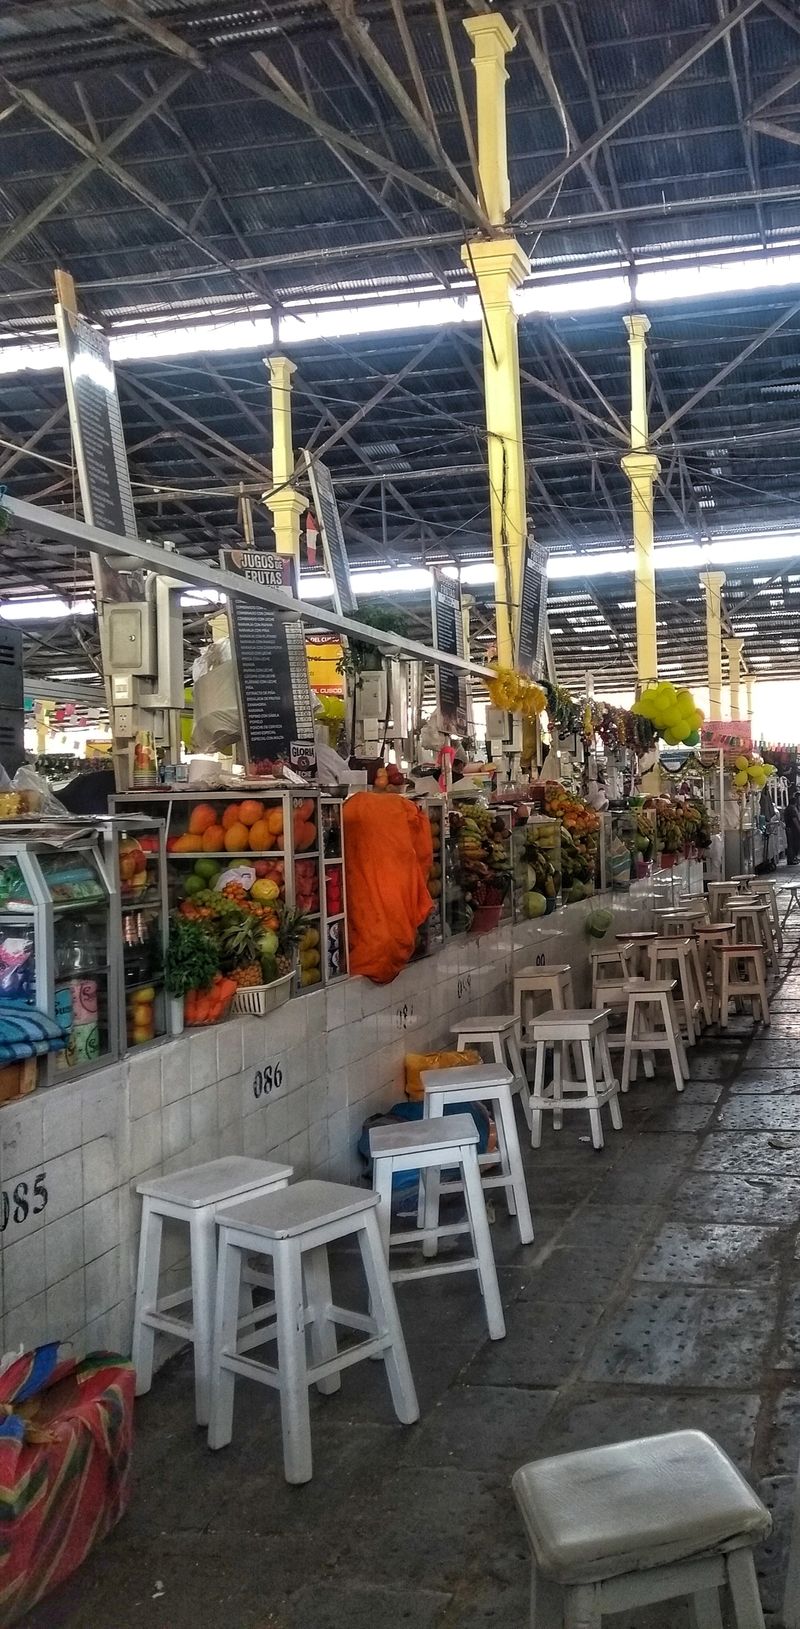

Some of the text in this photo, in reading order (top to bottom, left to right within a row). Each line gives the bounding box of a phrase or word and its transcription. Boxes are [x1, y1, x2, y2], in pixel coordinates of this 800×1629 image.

[241, 553, 283, 570] JUGOS DE
[245, 570, 283, 585] FRUTAS
[291, 746, 315, 758] GLORIA
[253, 1061, 283, 1099] 086
